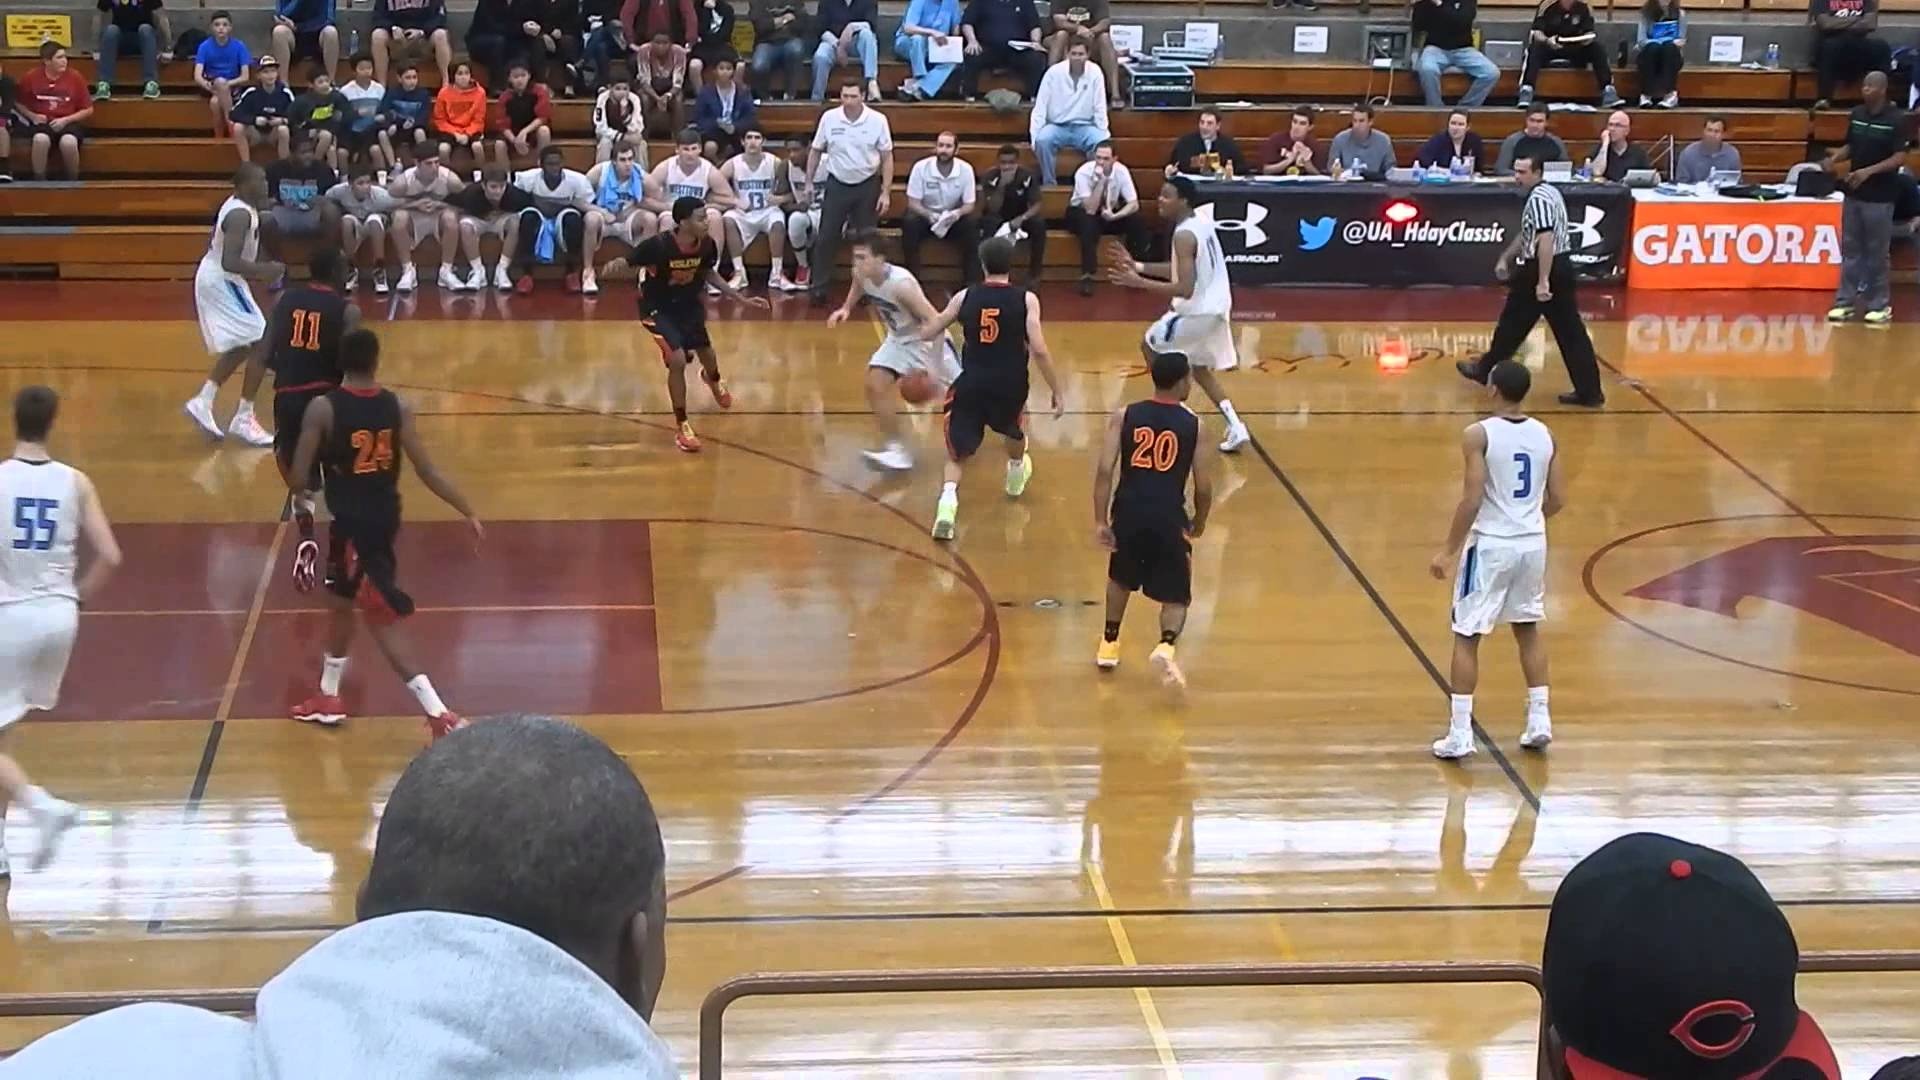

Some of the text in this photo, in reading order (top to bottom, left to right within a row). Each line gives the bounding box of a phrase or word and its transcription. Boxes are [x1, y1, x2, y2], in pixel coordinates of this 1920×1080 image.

[1343, 219, 1505, 247] @UA_HdayClassic
[1224, 254, 1281, 264] ARMOUR
[290, 309, 321, 350] 11
[980, 308, 1000, 343] 5
[351, 429, 393, 474] 24
[1131, 426, 1178, 471] 20
[1513, 452, 1531, 498] 3
[12, 496, 60, 551] 55
